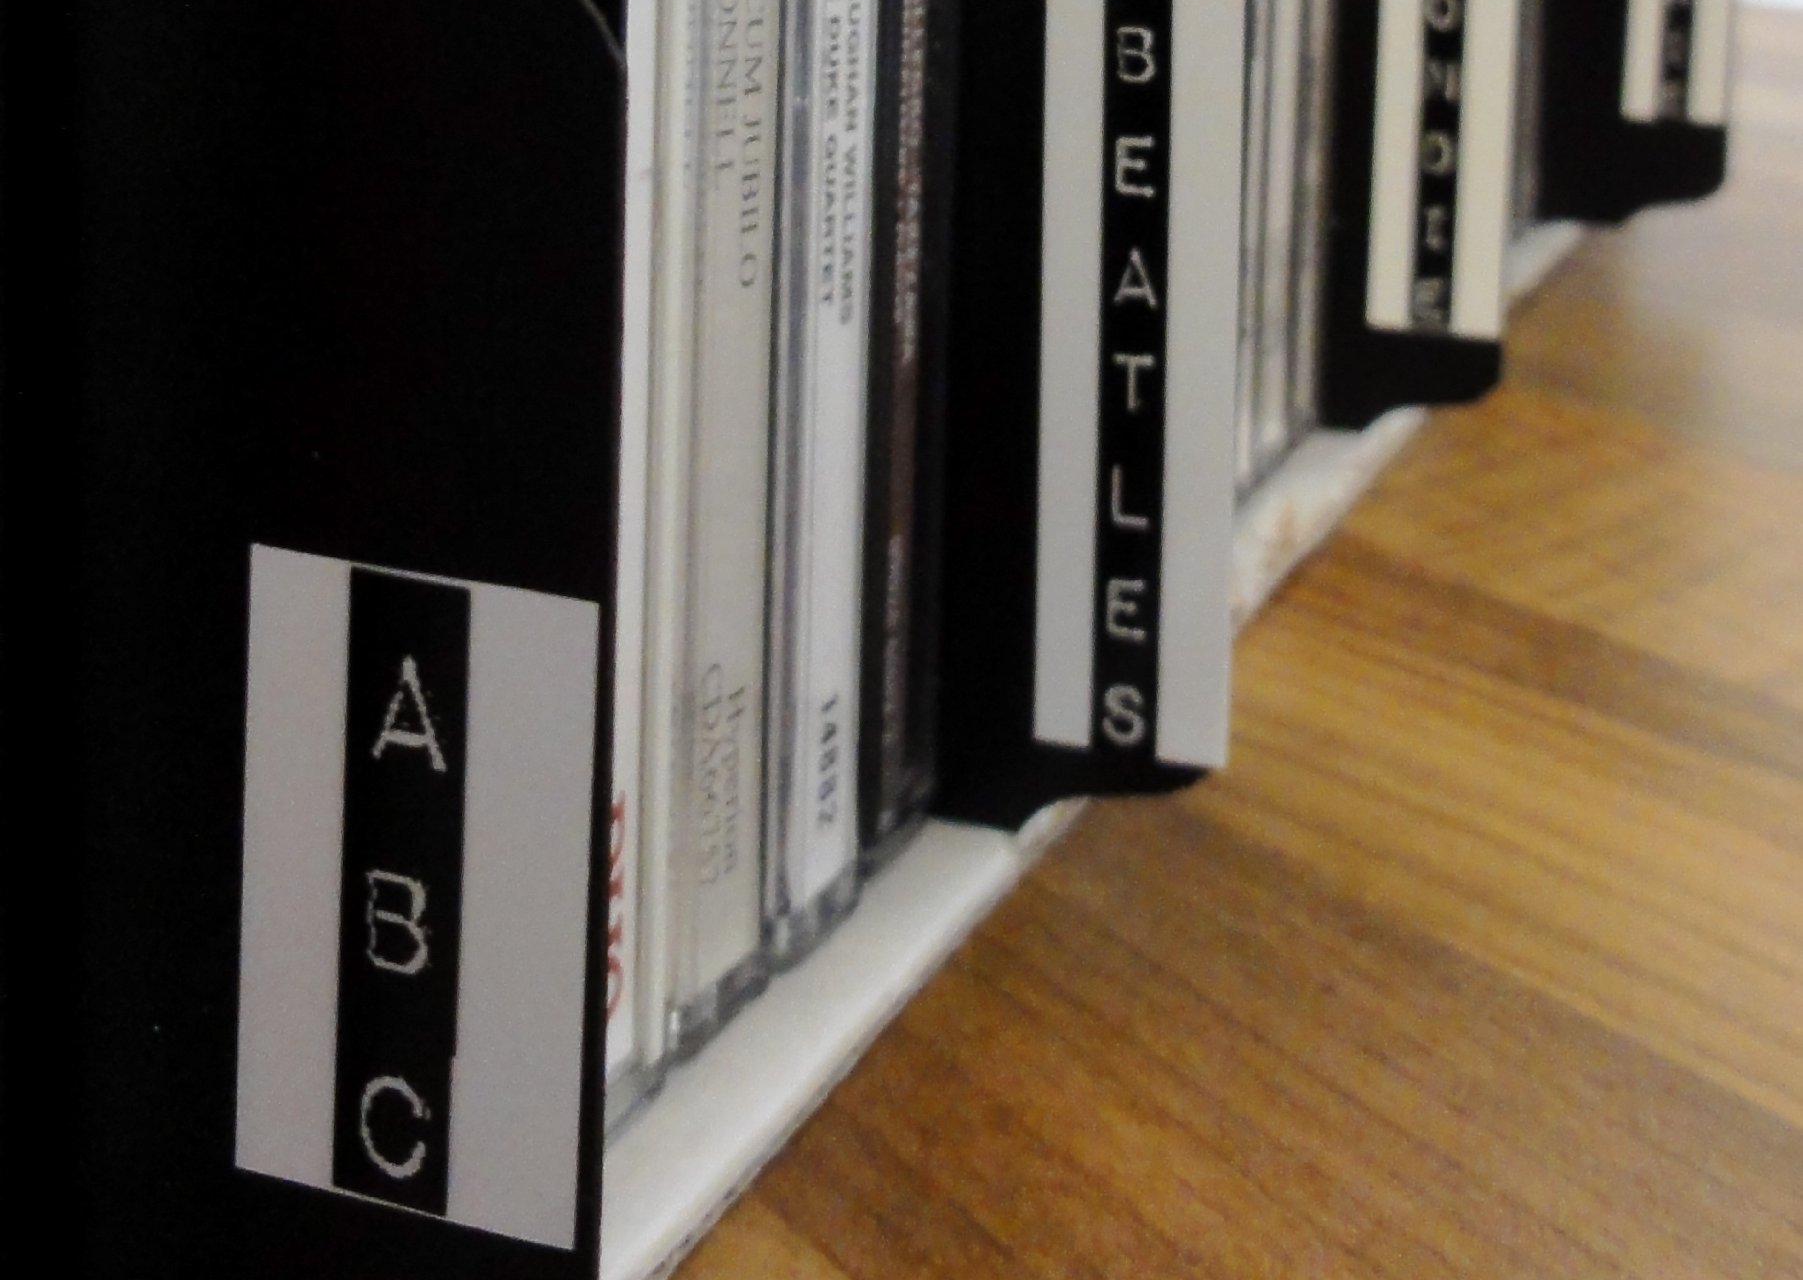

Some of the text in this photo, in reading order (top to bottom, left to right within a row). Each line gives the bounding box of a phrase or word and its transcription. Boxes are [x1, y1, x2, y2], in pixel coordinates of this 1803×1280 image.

[825, 16, 842, 116] DUKE
[739, 118, 762, 288] JUBILO
[821, 132, 839, 305] QUARTET
[839, 143, 858, 325] WILLIAMS
[1100, 24, 1160, 746] BEATLES
[358, 655, 448, 1181] ABC
